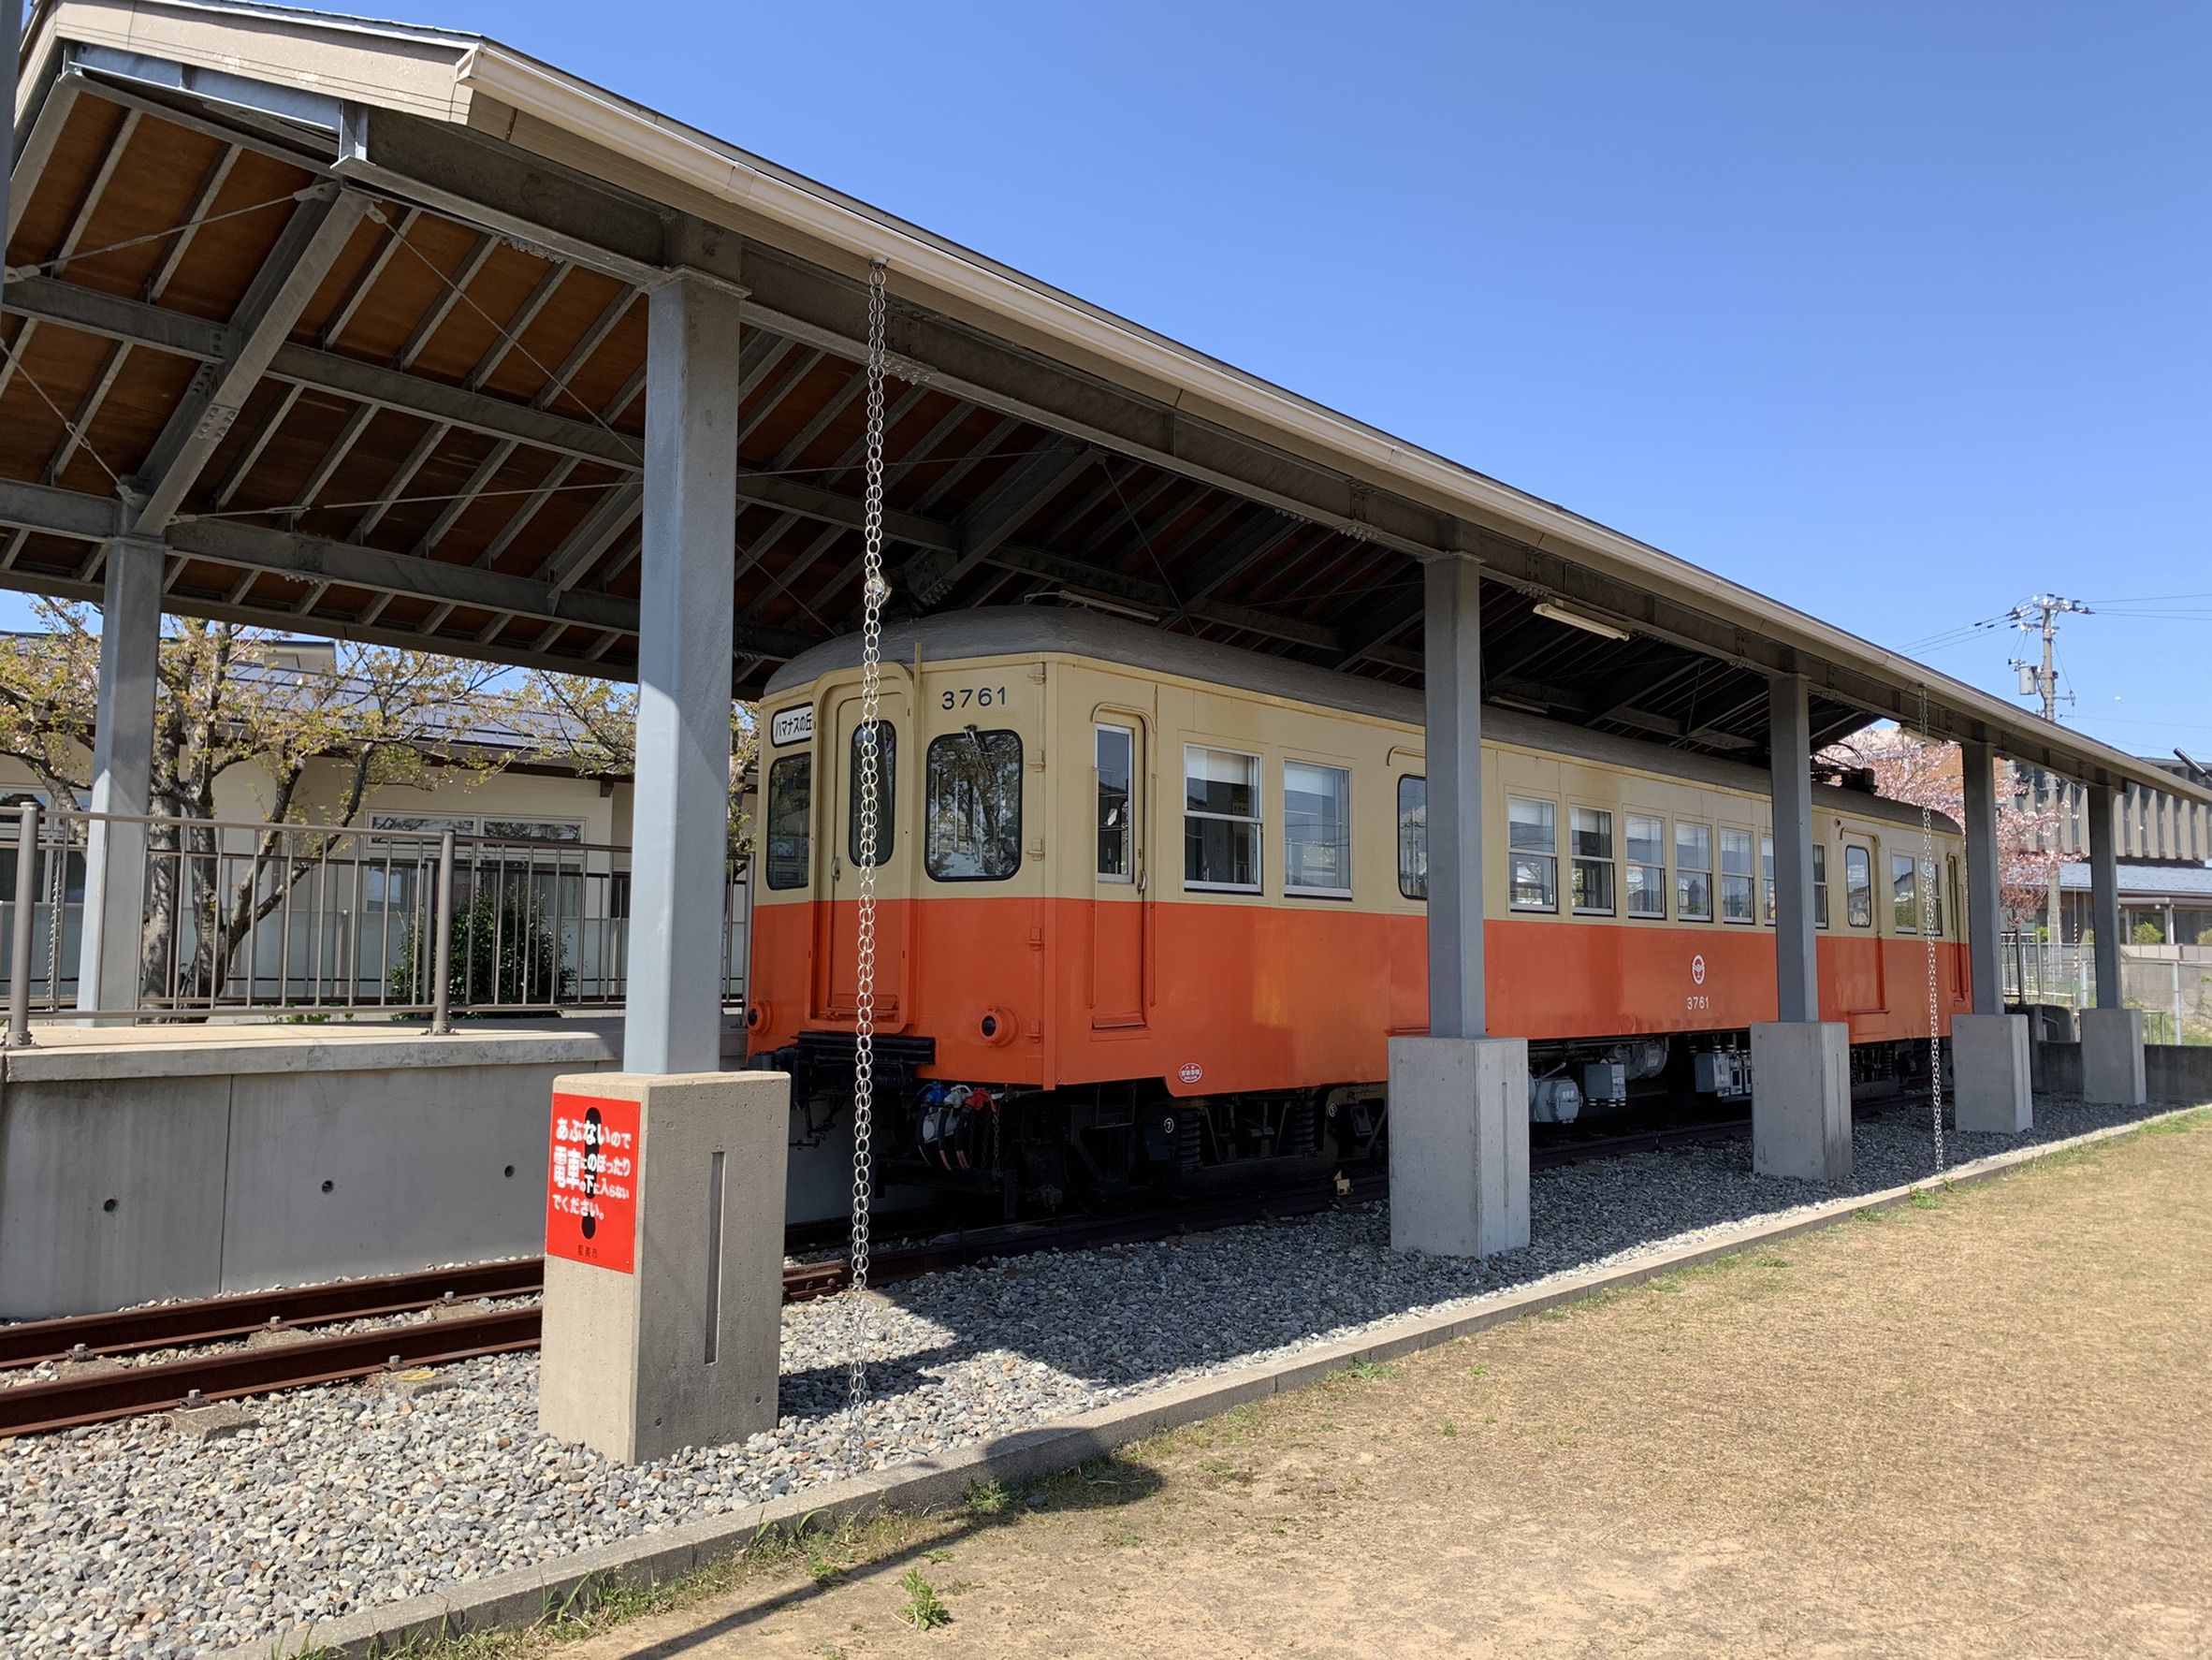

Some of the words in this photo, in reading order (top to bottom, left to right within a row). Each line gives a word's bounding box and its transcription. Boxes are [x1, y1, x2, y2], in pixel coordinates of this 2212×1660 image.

[940, 685, 1007, 711] 3761
[1686, 996, 1710, 1011] 3761
[555, 1116, 632, 1149] あぶないので
[552, 1194, 604, 1220] でください。
